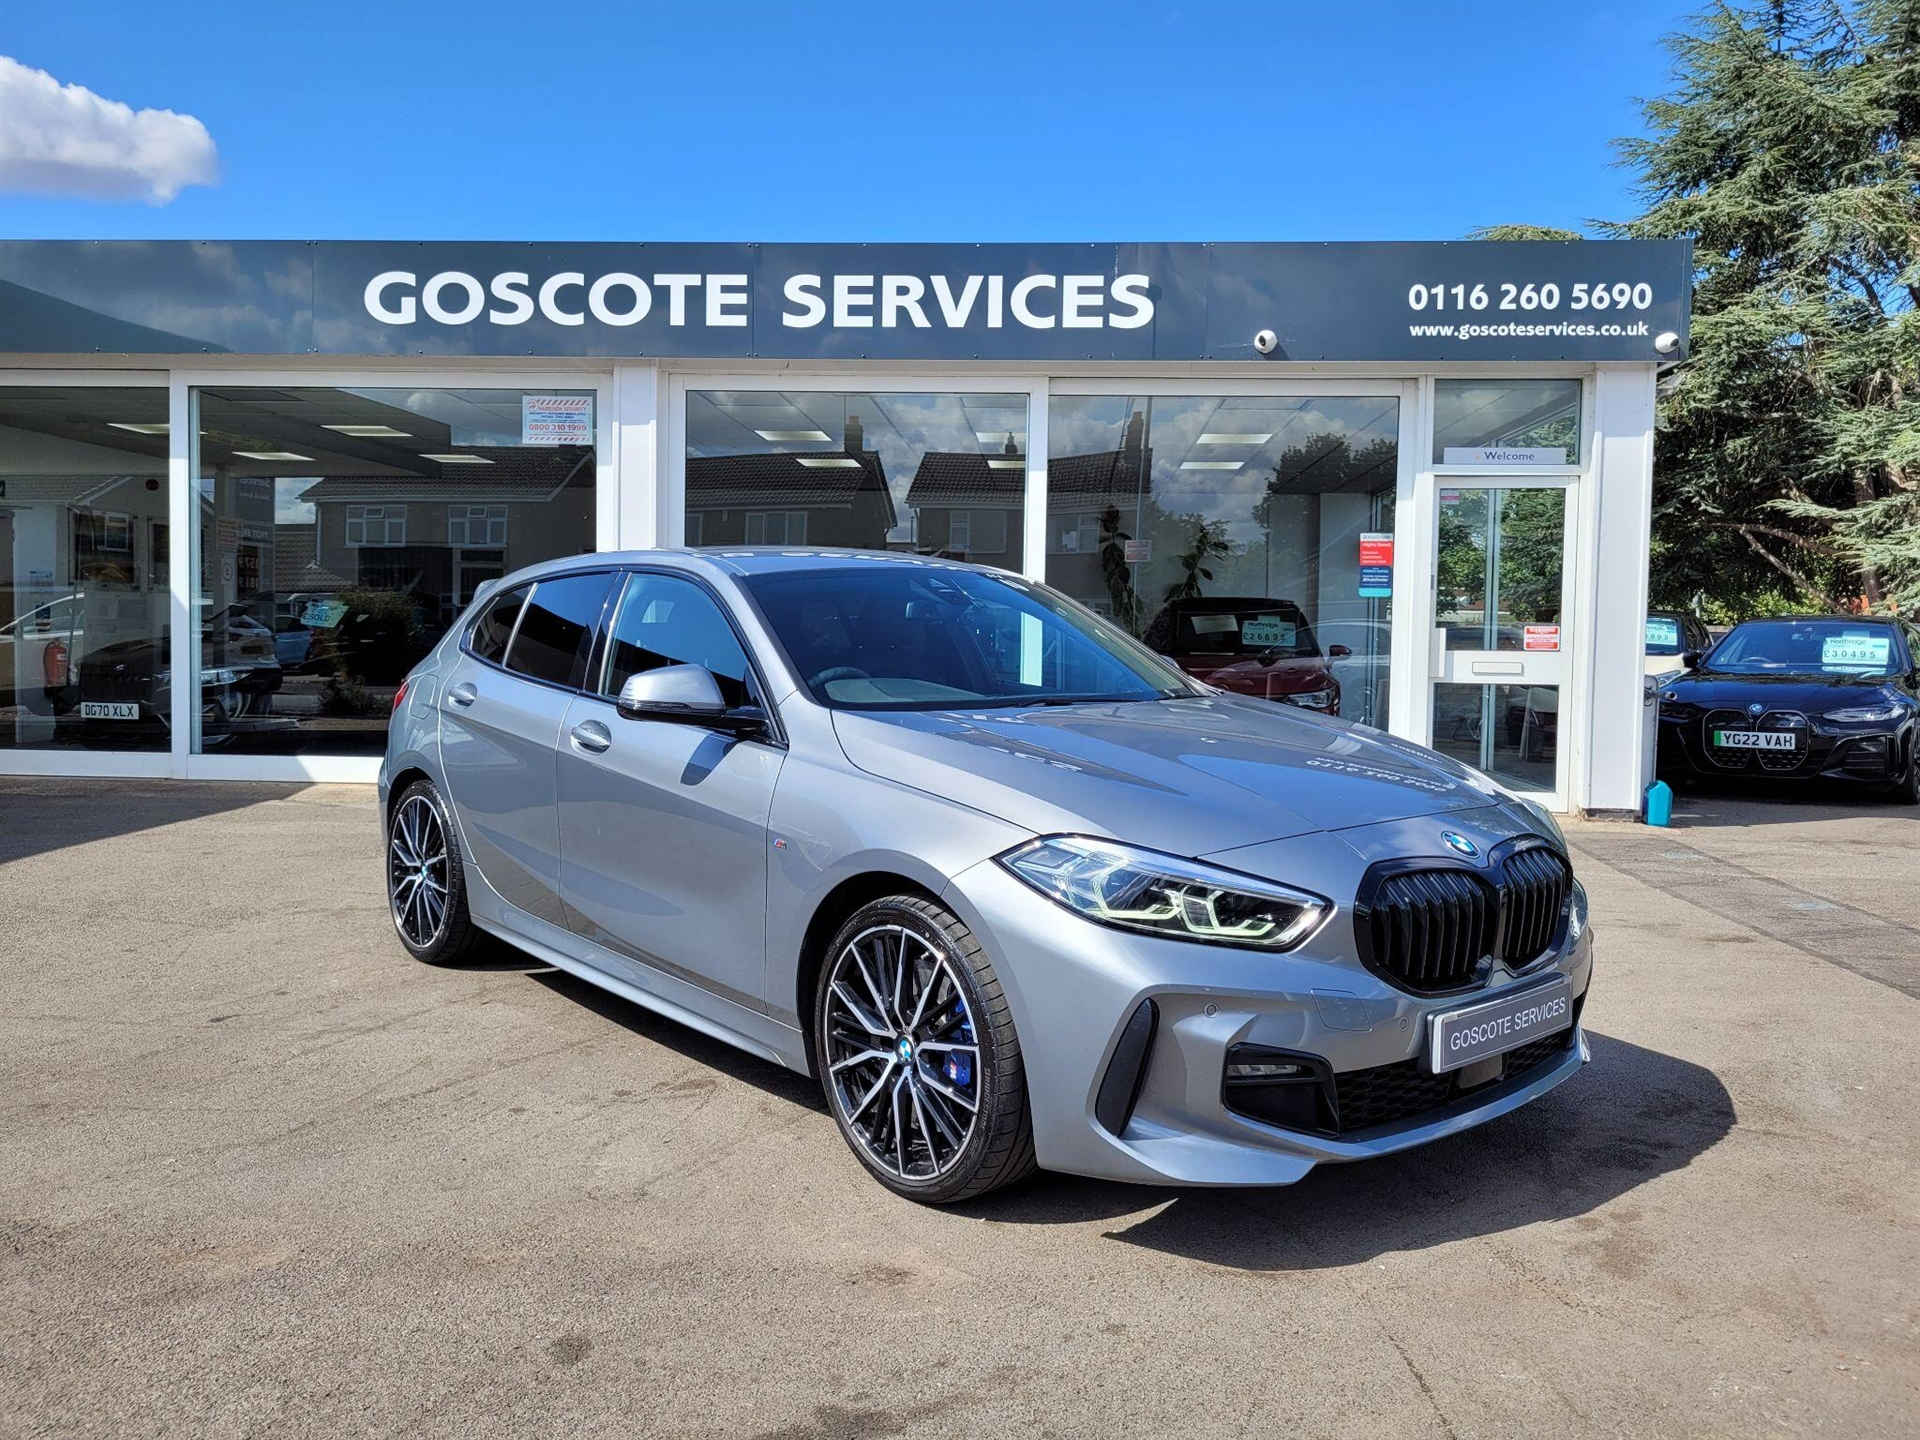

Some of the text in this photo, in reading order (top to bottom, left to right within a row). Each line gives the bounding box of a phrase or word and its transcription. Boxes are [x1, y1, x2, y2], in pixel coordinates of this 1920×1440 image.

[363, 271, 1155, 330] GOSCOTE SERVICES
[1408, 282, 1653, 311] 0116 260 5690
[1409, 321, 1649, 340] www.goscoteservices.co.uk
[1484, 451, 1535, 461] Welcome
[1829, 638, 1867, 646] Northridge
[1823, 650, 1876, 659] £30495
[84, 704, 134, 717] DG70 XLX
[1723, 733, 1793, 747] YG22 VAH
[1450, 997, 1566, 1050] GOSCOTE SERVICES
